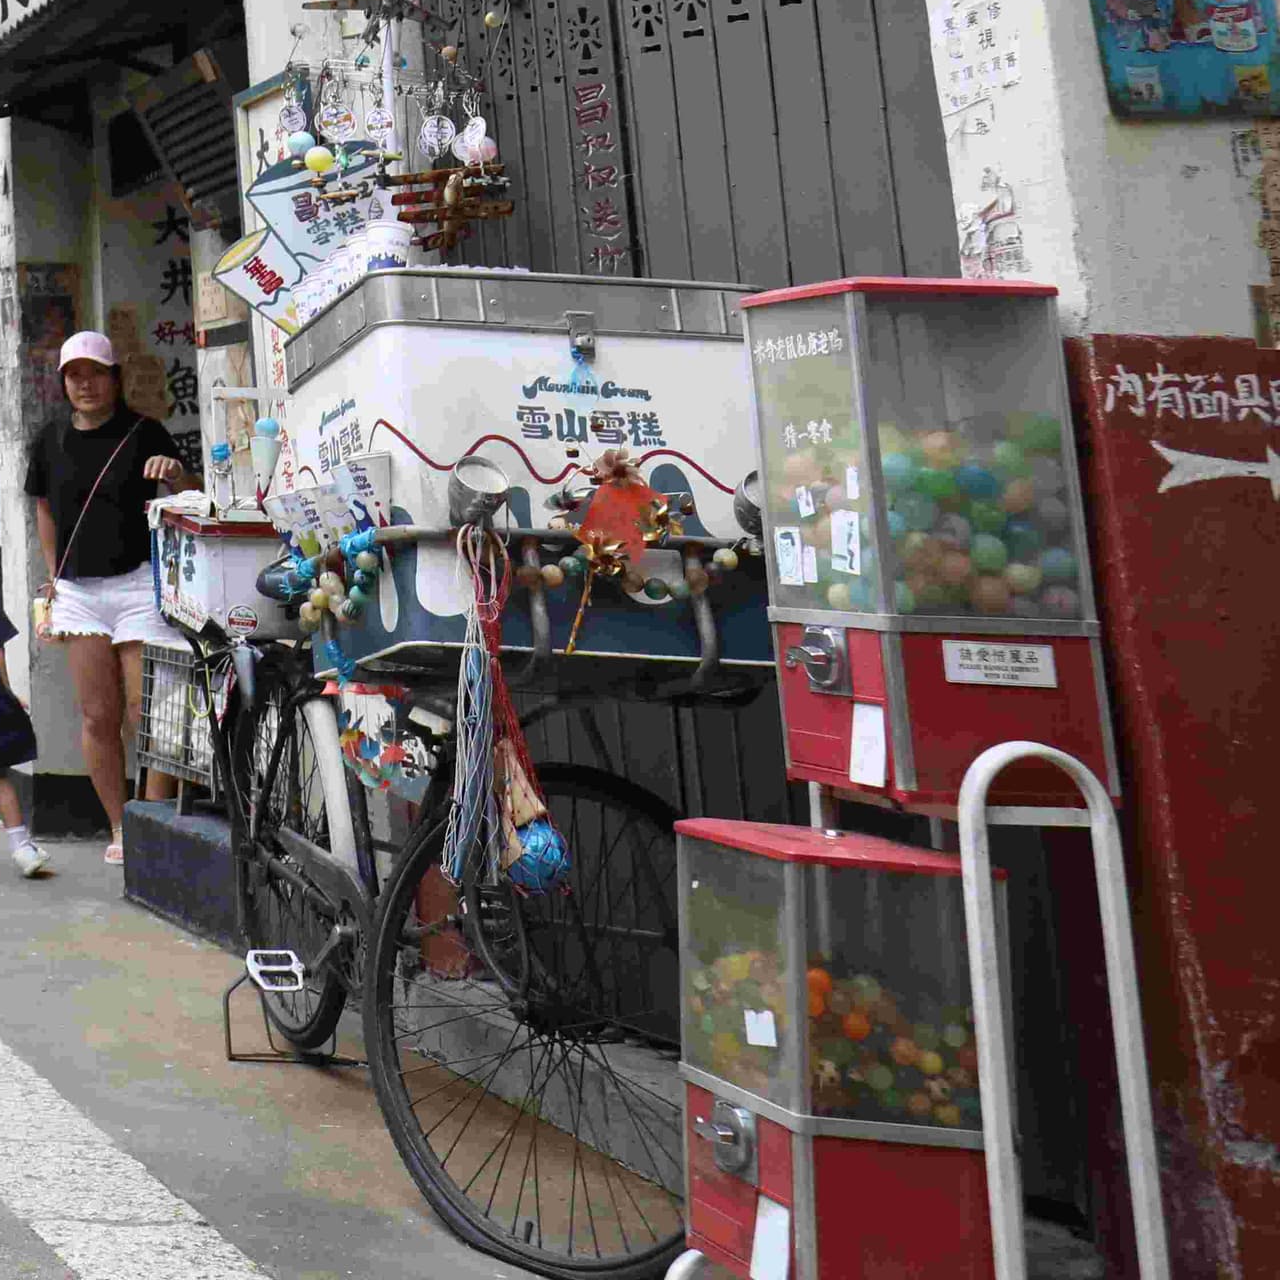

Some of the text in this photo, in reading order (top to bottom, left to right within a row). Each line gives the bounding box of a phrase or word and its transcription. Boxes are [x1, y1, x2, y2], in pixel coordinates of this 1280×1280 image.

[522, 375, 652, 402] Mountain Cream
[515, 404, 667, 447] 雪山雪糕
